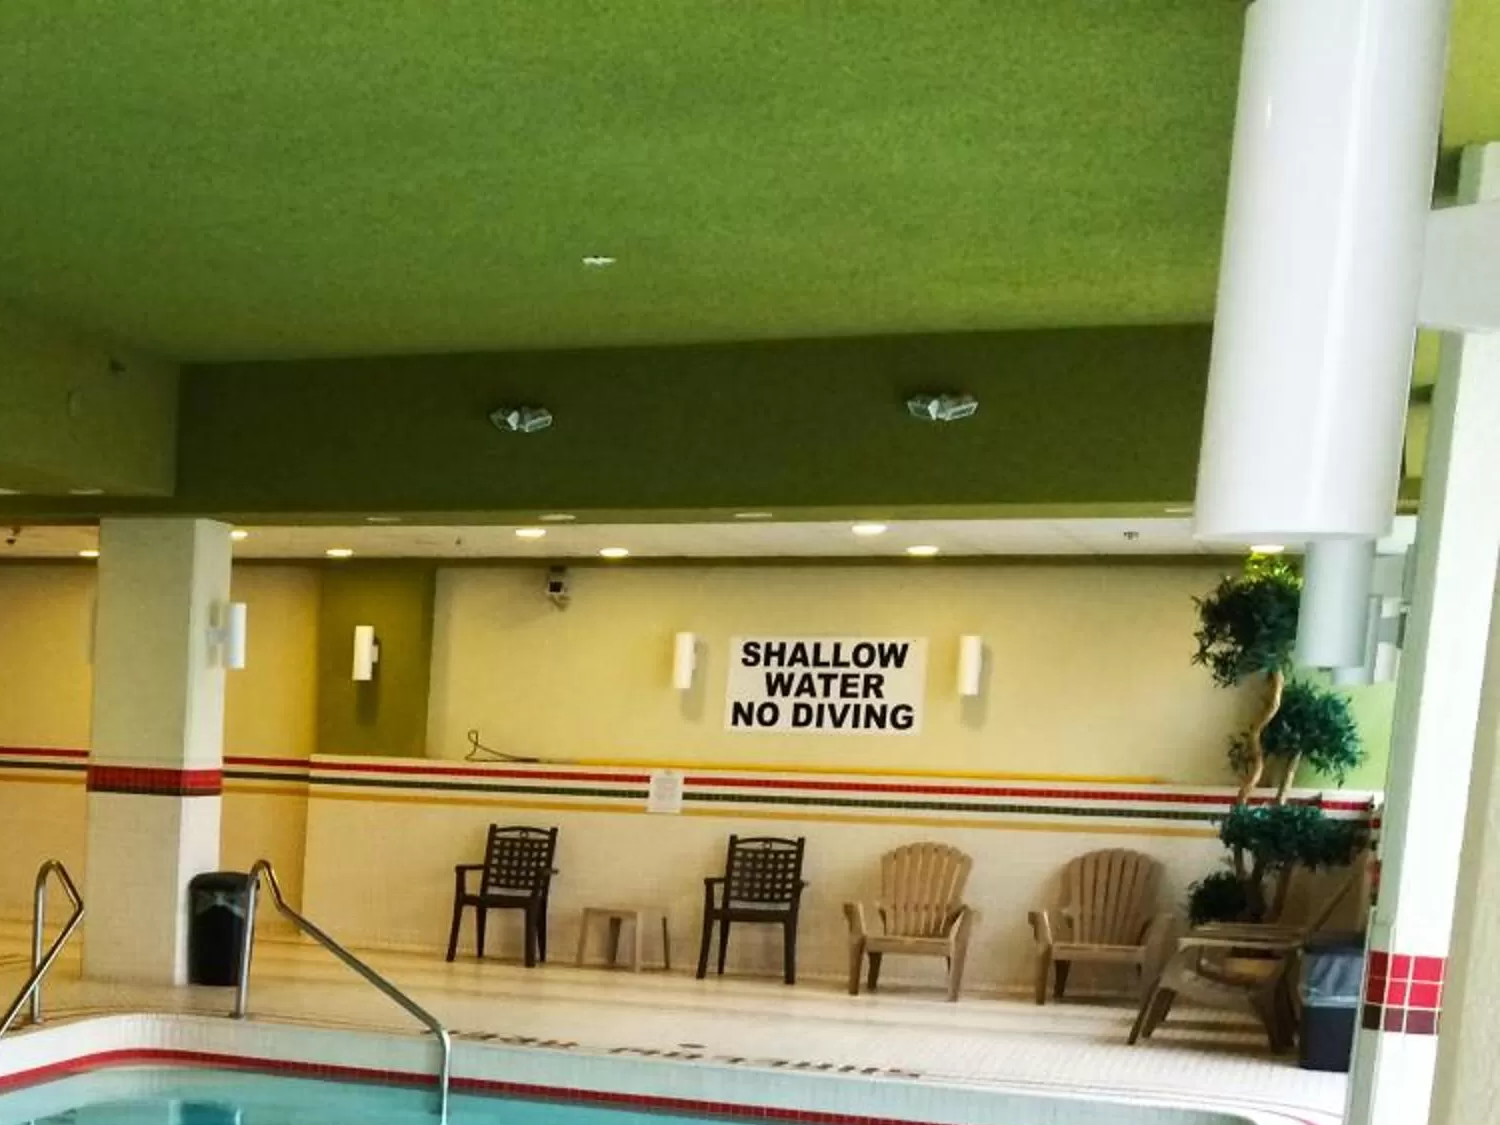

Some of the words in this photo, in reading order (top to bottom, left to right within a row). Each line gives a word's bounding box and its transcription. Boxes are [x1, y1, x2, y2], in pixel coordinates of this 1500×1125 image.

[741, 641, 909, 668] SHALLOW
[765, 672, 885, 699] WATER
[731, 702, 779, 727] NO
[791, 703, 914, 730] DIVING
